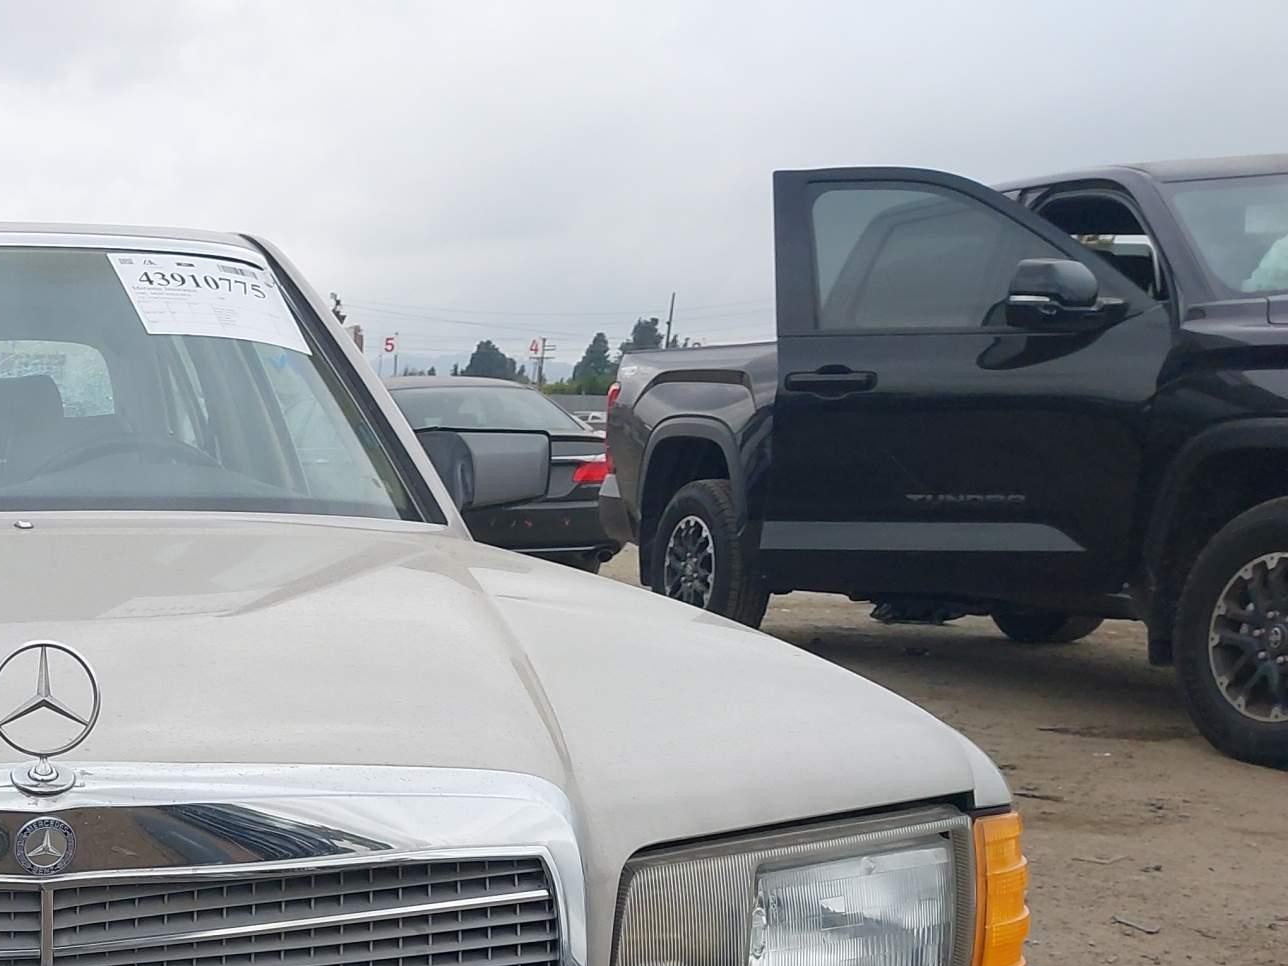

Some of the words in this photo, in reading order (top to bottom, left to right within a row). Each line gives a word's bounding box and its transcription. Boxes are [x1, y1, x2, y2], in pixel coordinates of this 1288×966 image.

[138, 271, 266, 299] 43910775
[384, 337, 395, 352] 5
[529, 339, 539, 354] 4
